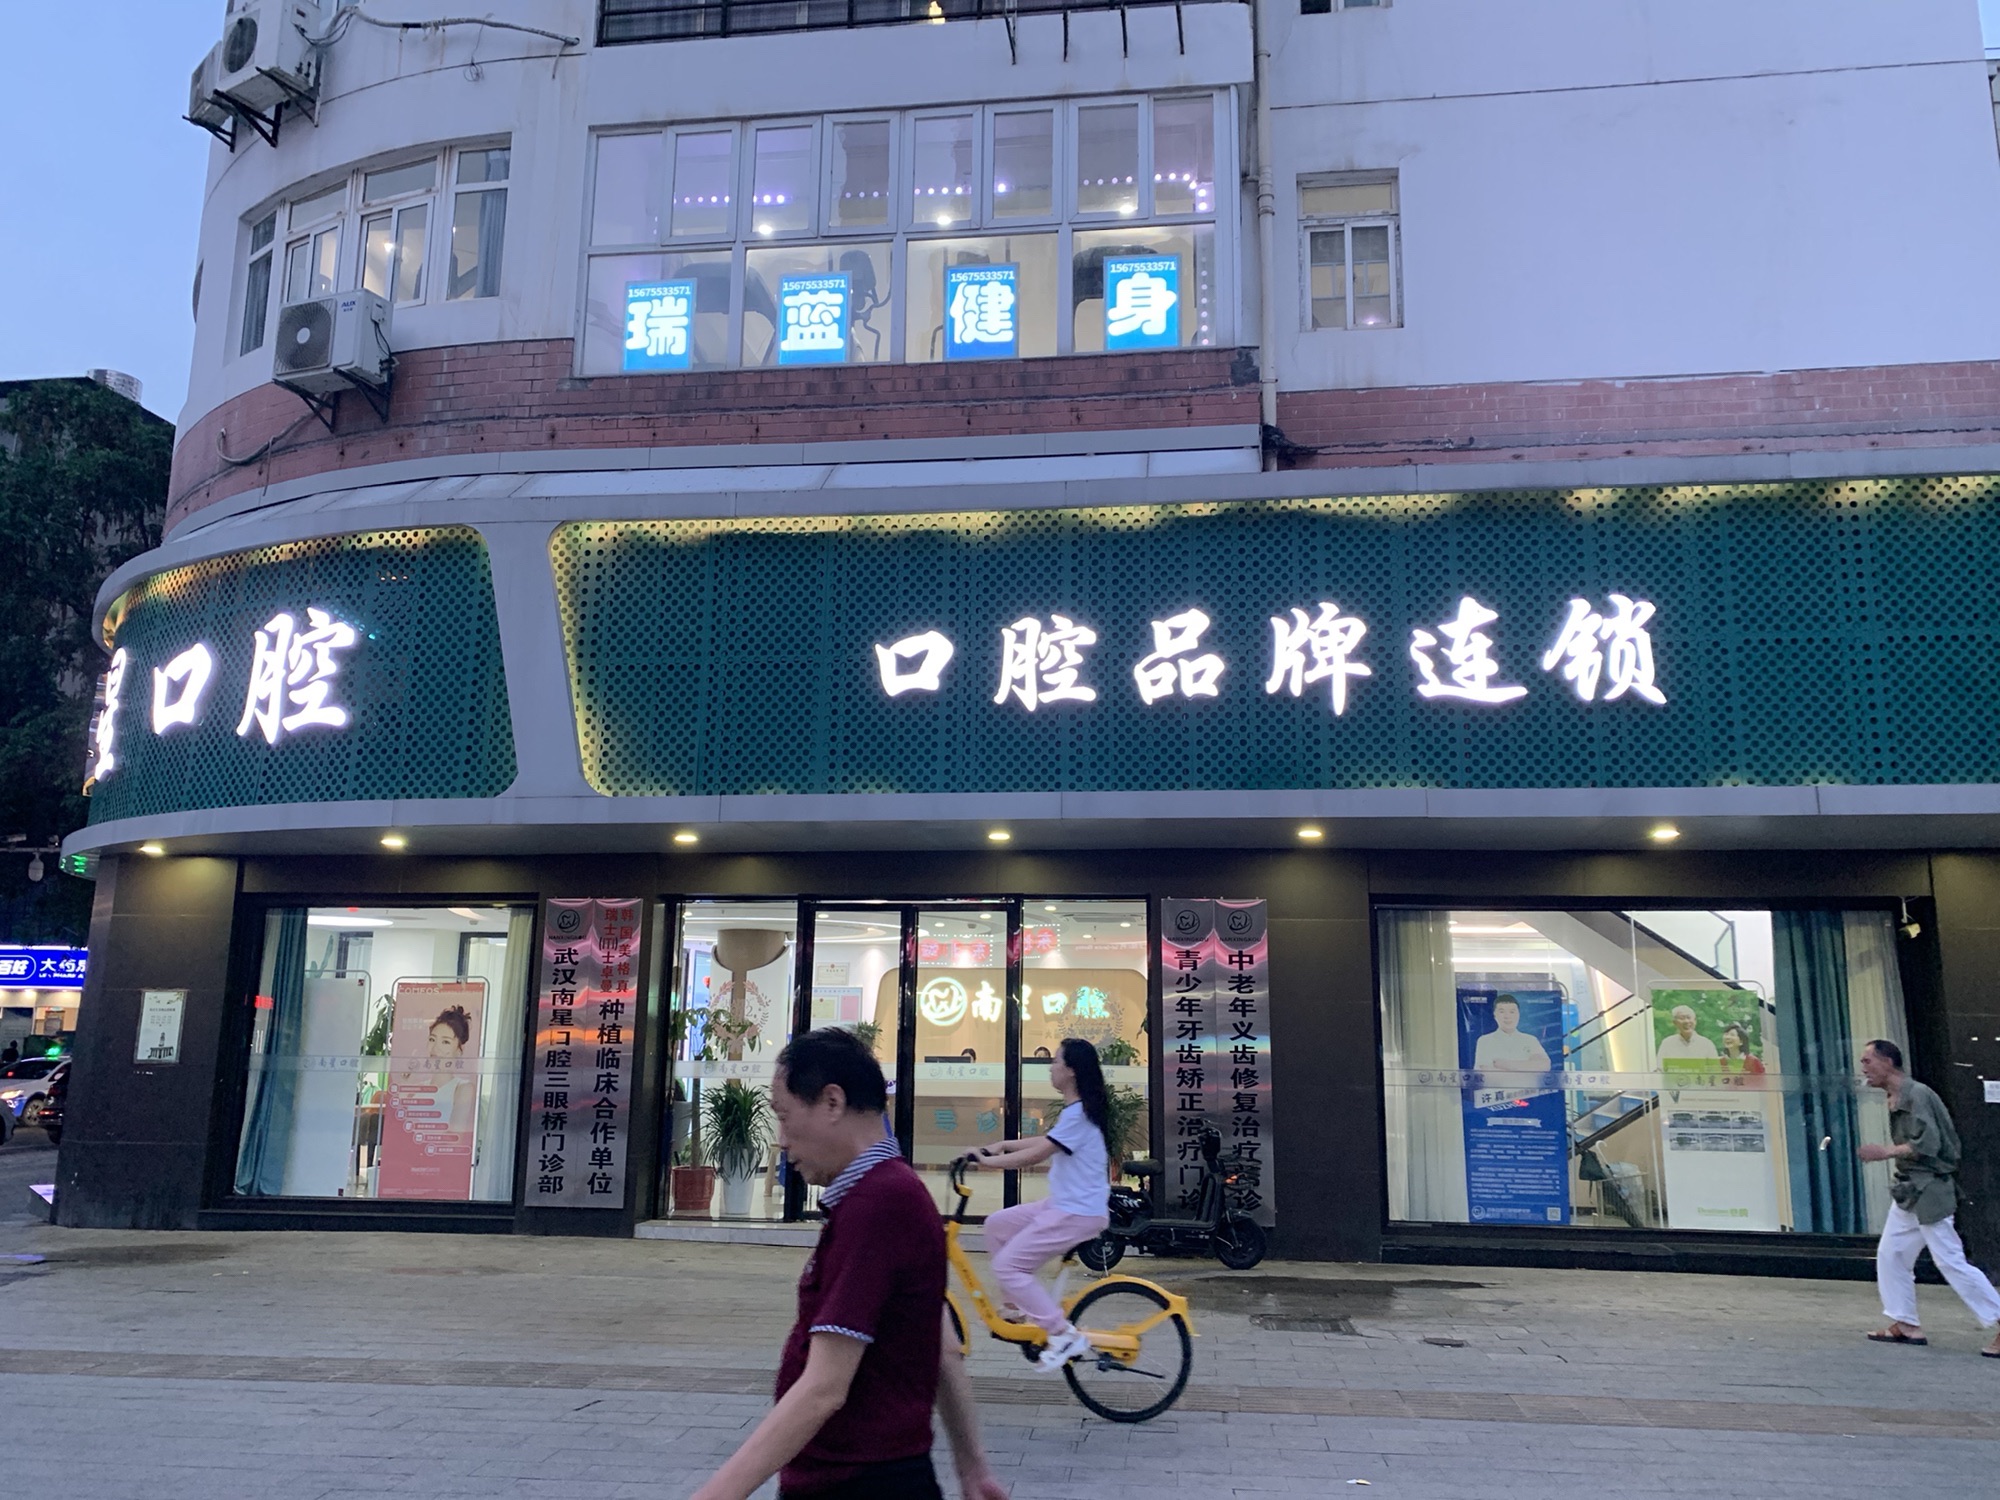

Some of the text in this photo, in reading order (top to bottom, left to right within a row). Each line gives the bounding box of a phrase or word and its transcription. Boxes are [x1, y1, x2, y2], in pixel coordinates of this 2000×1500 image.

[628, 286, 691, 298] 15675533571
[783, 279, 846, 291] 15675533571
[950, 270, 1015, 282] 15675533571
[1110, 261, 1176, 273] 15675533571
[625, 272, 1177, 357] 瑞 蓝 健 身
[875, 594, 1667, 716] 口腔品牌连锁
[617, 908, 634, 993] 韩国美格真
[538, 948, 579, 1194] 武汉南星口腔三眼桥门诊部
[587, 999, 624, 1194] 种植临床合作单位
